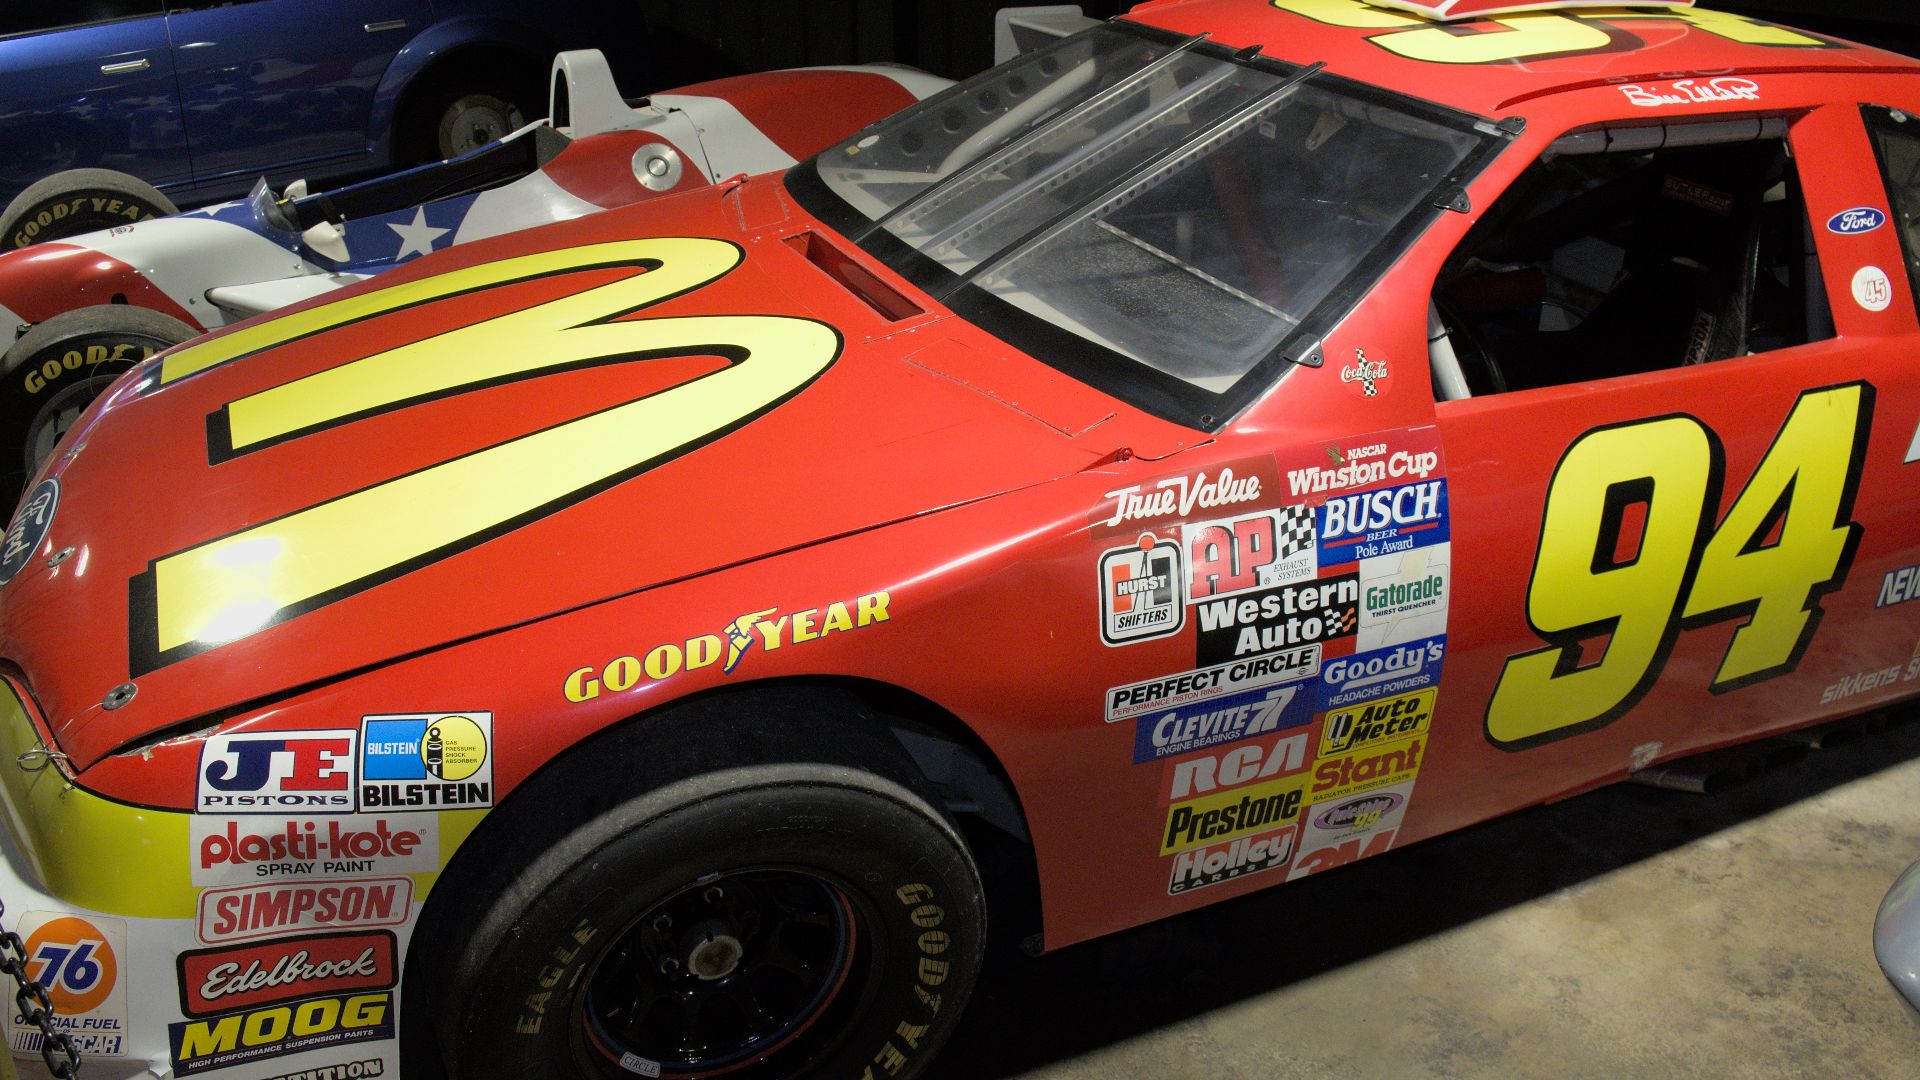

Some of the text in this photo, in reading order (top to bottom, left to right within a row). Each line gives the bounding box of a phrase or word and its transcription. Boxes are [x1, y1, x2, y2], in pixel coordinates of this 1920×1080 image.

[14, 199, 156, 249] GOODYEA
[1840, 211, 1876, 231] Ford
[1864, 278, 1888, 303] 45
[1347, 444, 1387, 460] NASCAR
[1288, 450, 1438, 496] Winston Cup
[1321, 481, 1441, 539] BUSCH
[1355, 536, 1413, 559] Pole Award
[1366, 529, 1398, 542] BEER
[1190, 515, 1276, 599] AP
[1274, 558, 1309, 573] EXHAUST
[1278, 567, 1311, 581] SYSTEMS
[1483, 379, 1877, 753] 94
[1116, 575, 1167, 596] HURST
[1366, 575, 1443, 611] Gatorade
[1118, 609, 1168, 629] SHIFTERS
[1199, 579, 1358, 632] Western
[1372, 600, 1436, 618] THIRST QUENCHER
[1234, 617, 1323, 656] Auto
[1112, 670, 1225, 710] PERFECT
[1229, 649, 1313, 682] CIRCLE
[1324, 641, 1444, 687] Goody's
[1112, 685, 1224, 717] PERFORMANCE PISTON RINGS
[1328, 674, 1431, 706] HEADACHE POWDERS
[1820, 664, 1902, 706] sikkens
[1350, 712, 1428, 745] Meter
[1357, 698, 1421, 727] Auto
[367, 741, 418, 756] BILSTEIN
[1156, 728, 1241, 757] ENGINE BEARINGS
[205, 738, 350, 791] JE
[1170, 732, 1308, 800] RCA
[1312, 740, 1421, 793] Stant
[203, 795, 349, 806] PISTONS
[363, 782, 489, 807] BILSTEIN
[1313, 788, 1351, 802] RADIATOR
[1352, 779, 1390, 791] PRESSURE
[1166, 789, 1303, 848] Prestone
[201, 820, 421, 869] plasti-kote
[1173, 831, 1293, 884] Holley
[256, 860, 375, 877] SPRAY PAINT
[1172, 864, 1257, 892] CARBS
[213, 885, 397, 935] SIMPSON
[34, 941, 102, 992] 76
[200, 947, 377, 1000] Edelbrock
[516, 918, 598, 1036] EAGLE
[14, 1015, 121, 1030] OCIAL FUEL
[178, 993, 389, 1061] MOOG
[188, 1030, 374, 1070] HIGH PERFORMANCE SUSPENSION PARTS
[624, 1055, 658, 1074] CIRCLE
